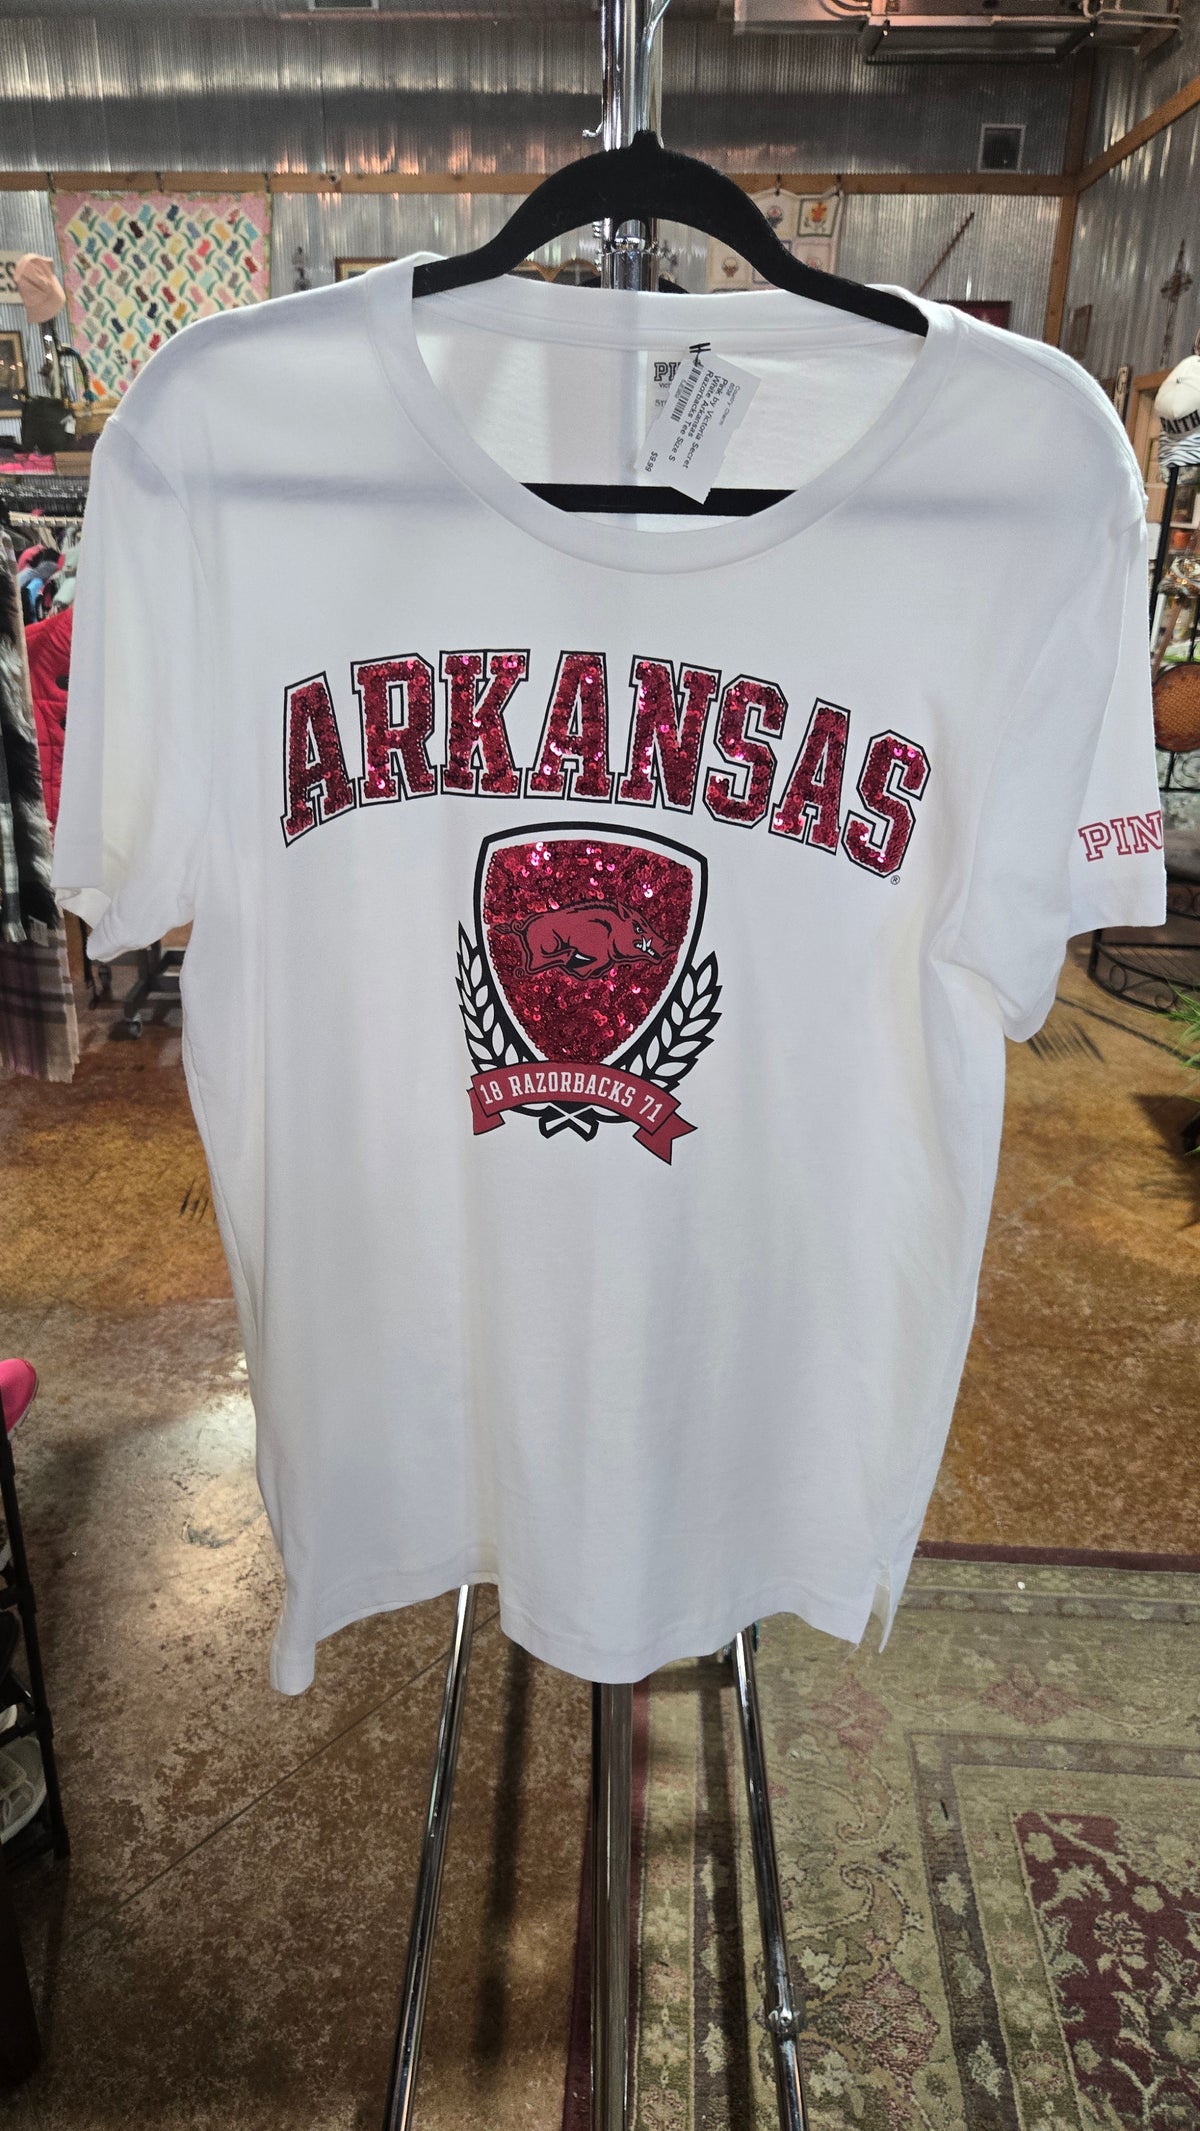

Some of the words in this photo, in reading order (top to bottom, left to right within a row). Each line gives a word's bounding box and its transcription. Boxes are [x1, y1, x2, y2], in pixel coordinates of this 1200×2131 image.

[654, 362, 681, 381] PI
[687, 369, 714, 418] Razorbacks
[705, 375, 721, 398] White
[715, 377, 728, 396] Pink
[709, 396, 719, 407] by
[680, 420, 691, 435] Tee
[687, 399, 710, 438] Arkansas
[695, 410, 714, 441] Victoria
[671, 436, 684, 453] Size
[682, 441, 699, 469] Secret
[644, 450, 658, 473] $9.99
[668, 454, 676, 462] S
[280, 649, 931, 878] ARKANSAS
[480, 1081, 503, 1104] 18
[508, 1072, 636, 1108] RAZORBACKS
[639, 1095, 663, 1123] 71
